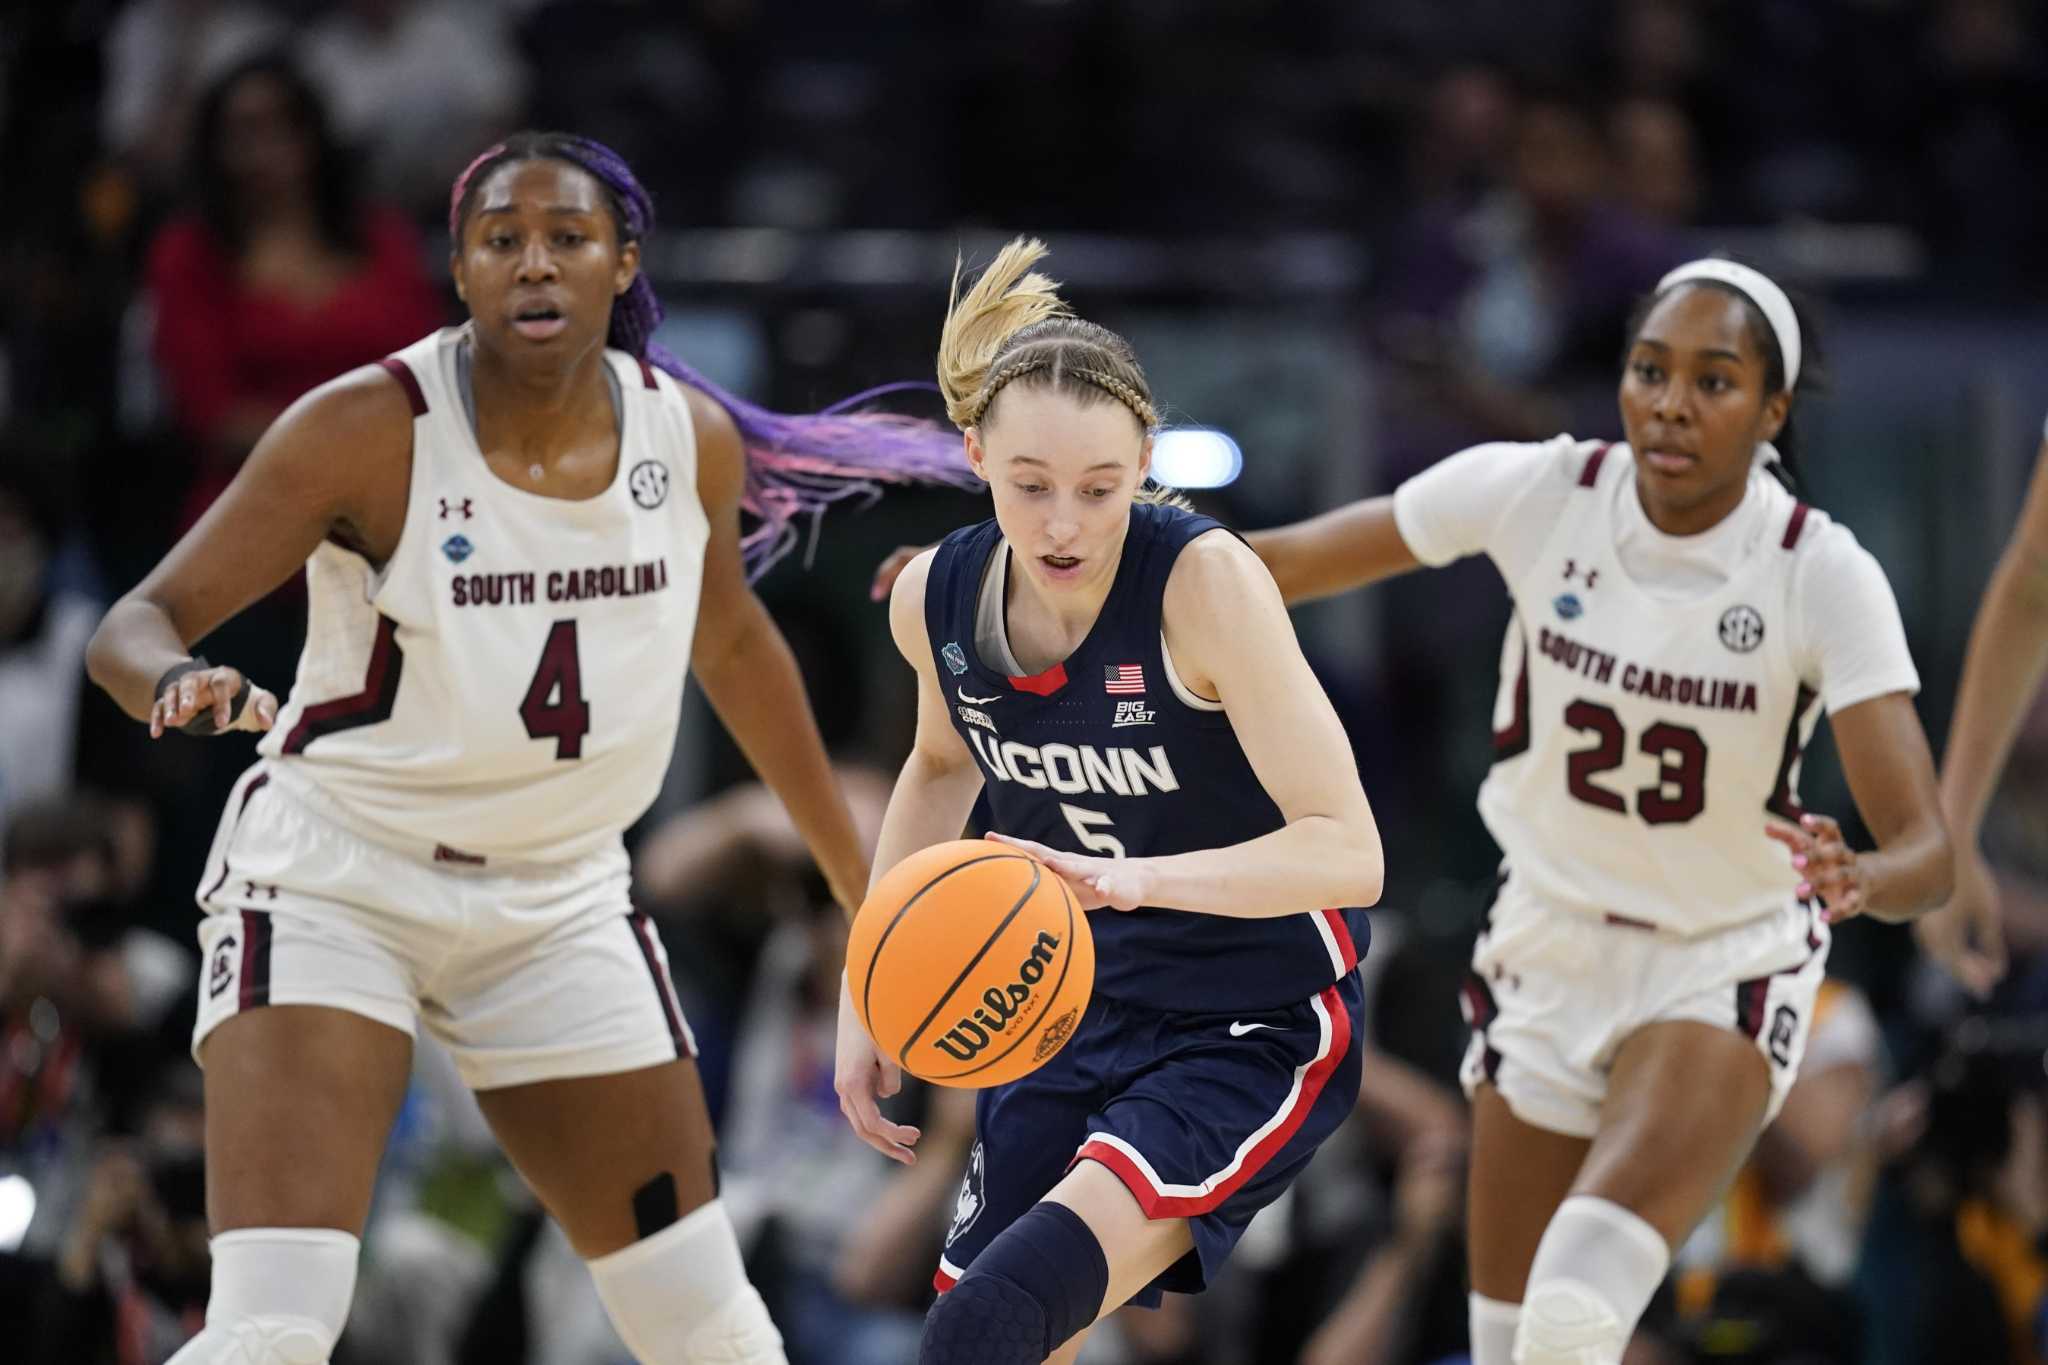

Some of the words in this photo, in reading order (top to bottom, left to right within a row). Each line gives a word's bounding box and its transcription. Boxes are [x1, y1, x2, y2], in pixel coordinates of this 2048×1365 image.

[452, 571, 535, 606] SOUTH
[519, 618, 590, 760] 4
[1539, 626, 1616, 684] SOUTH
[1621, 662, 1757, 713] CAROLINA
[1114, 711, 1156, 722] EAST
[1116, 701, 1145, 712] BIG
[968, 727, 1181, 796] UCONN
[1563, 698, 1708, 826] 23
[1059, 802, 1126, 859] 5
[933, 931, 1060, 1061] Wilson
